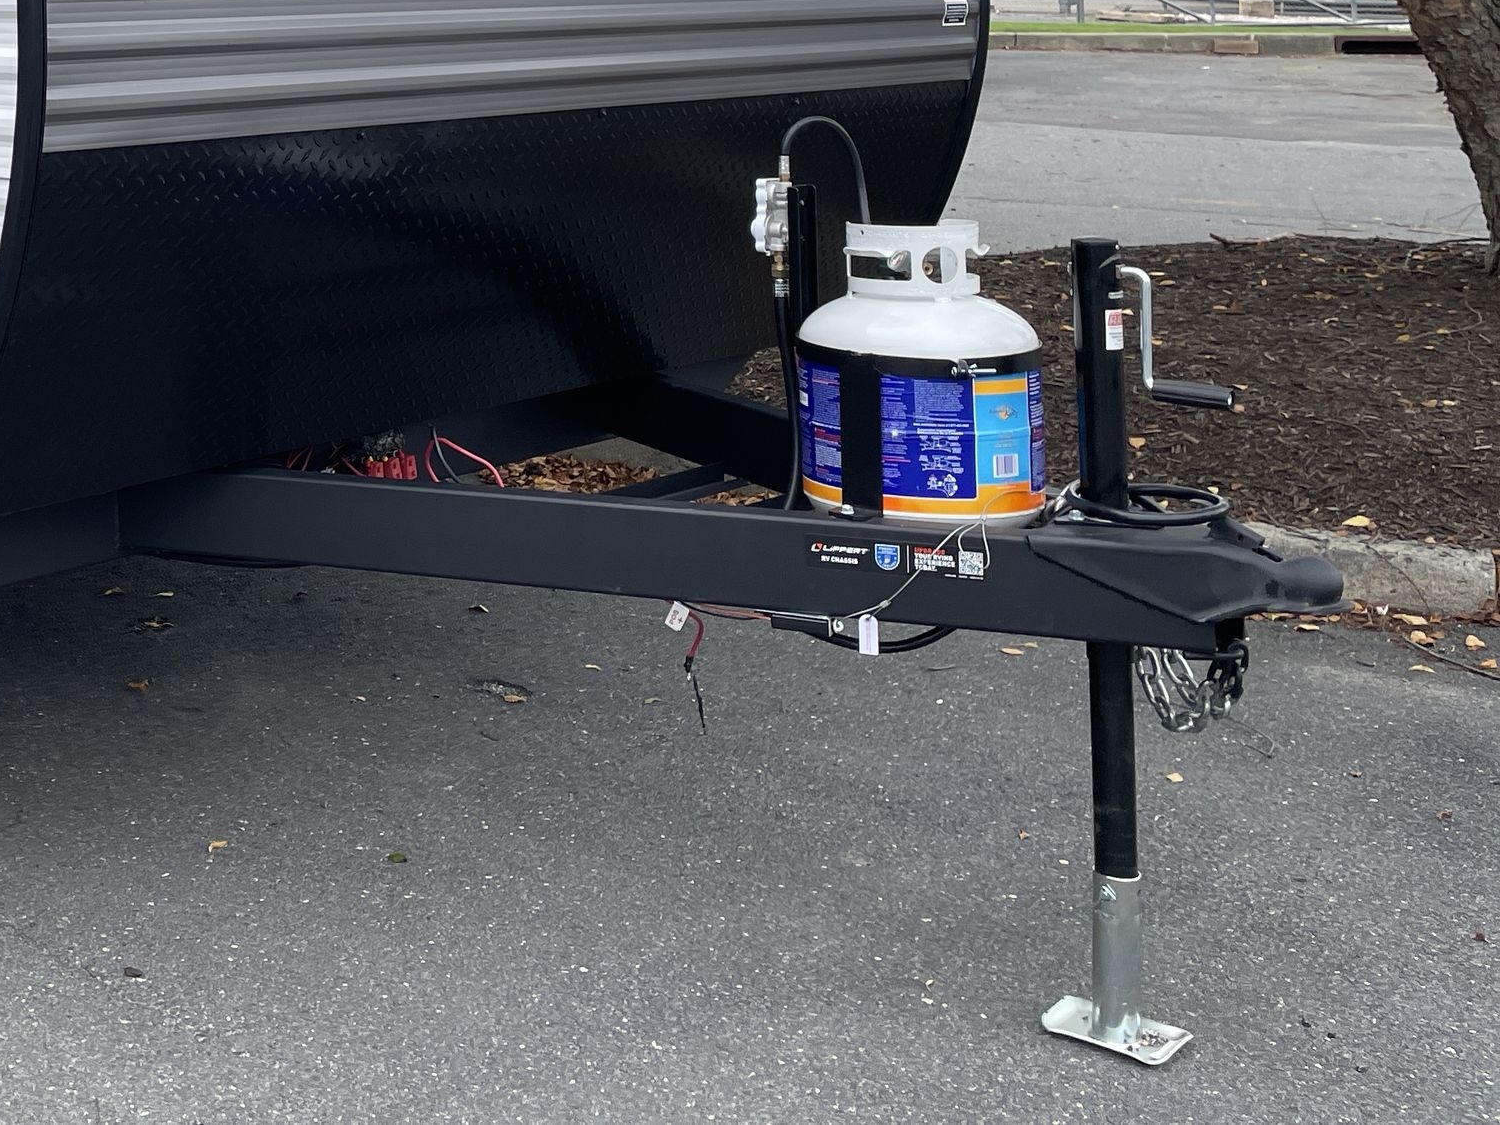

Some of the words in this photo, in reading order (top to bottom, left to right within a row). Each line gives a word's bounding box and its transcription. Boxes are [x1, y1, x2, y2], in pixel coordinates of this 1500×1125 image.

[822, 544, 869, 555] LIPPERT
[914, 546, 946, 556] UPGRDE
[831, 556, 859, 565] CHASSIS
